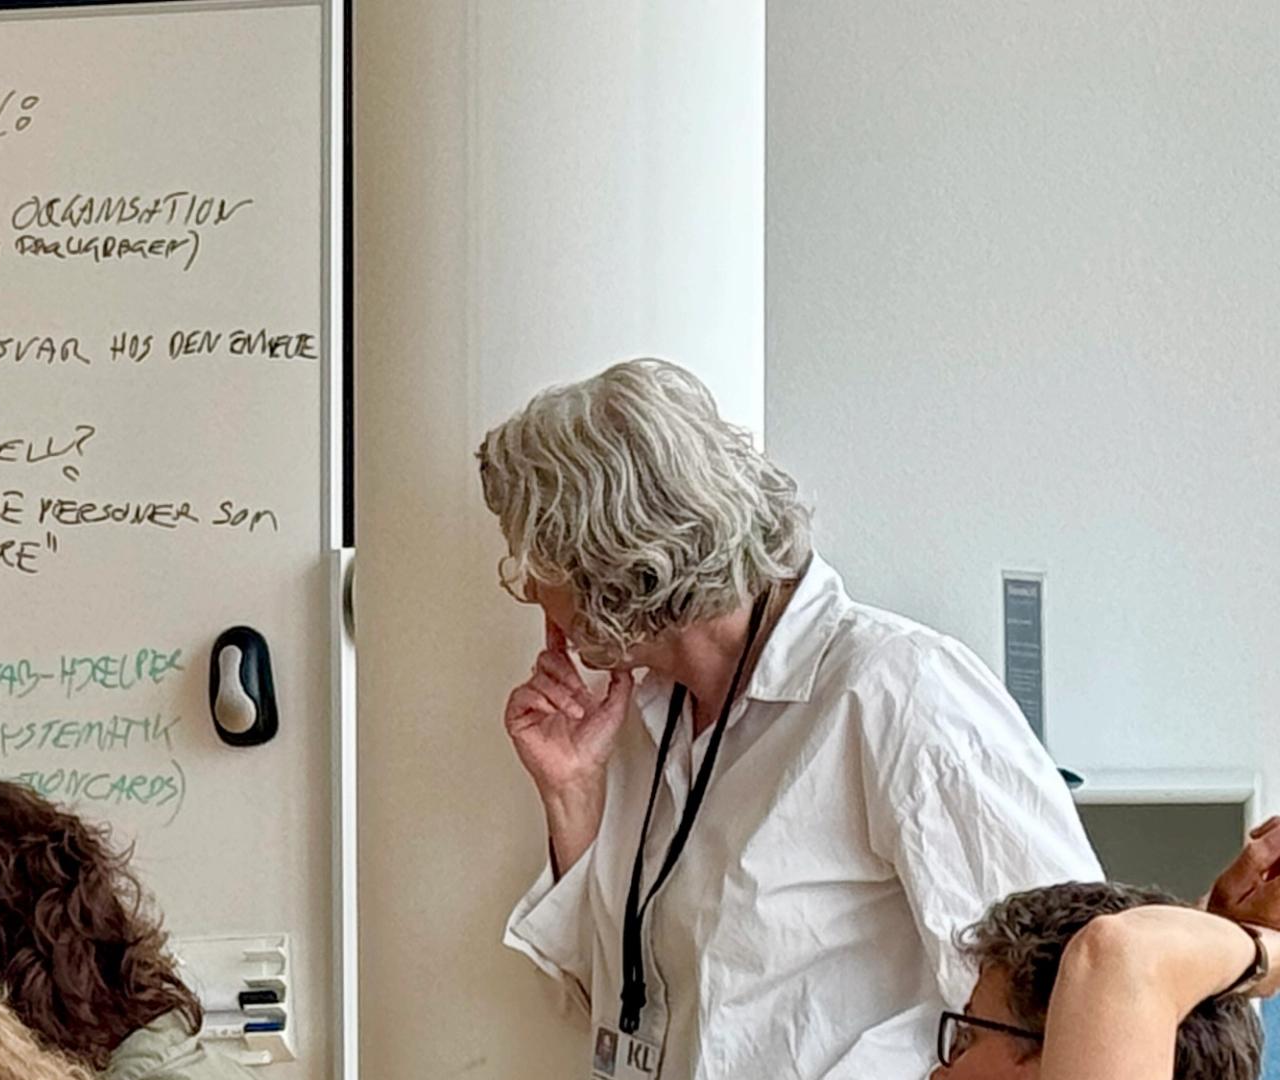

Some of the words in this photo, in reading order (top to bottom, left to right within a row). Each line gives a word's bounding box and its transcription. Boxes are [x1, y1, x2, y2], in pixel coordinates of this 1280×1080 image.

[110, 331, 154, 362] HOS
[169, 330, 223, 360] DEN
[626, 1039, 654, 1073] KL
